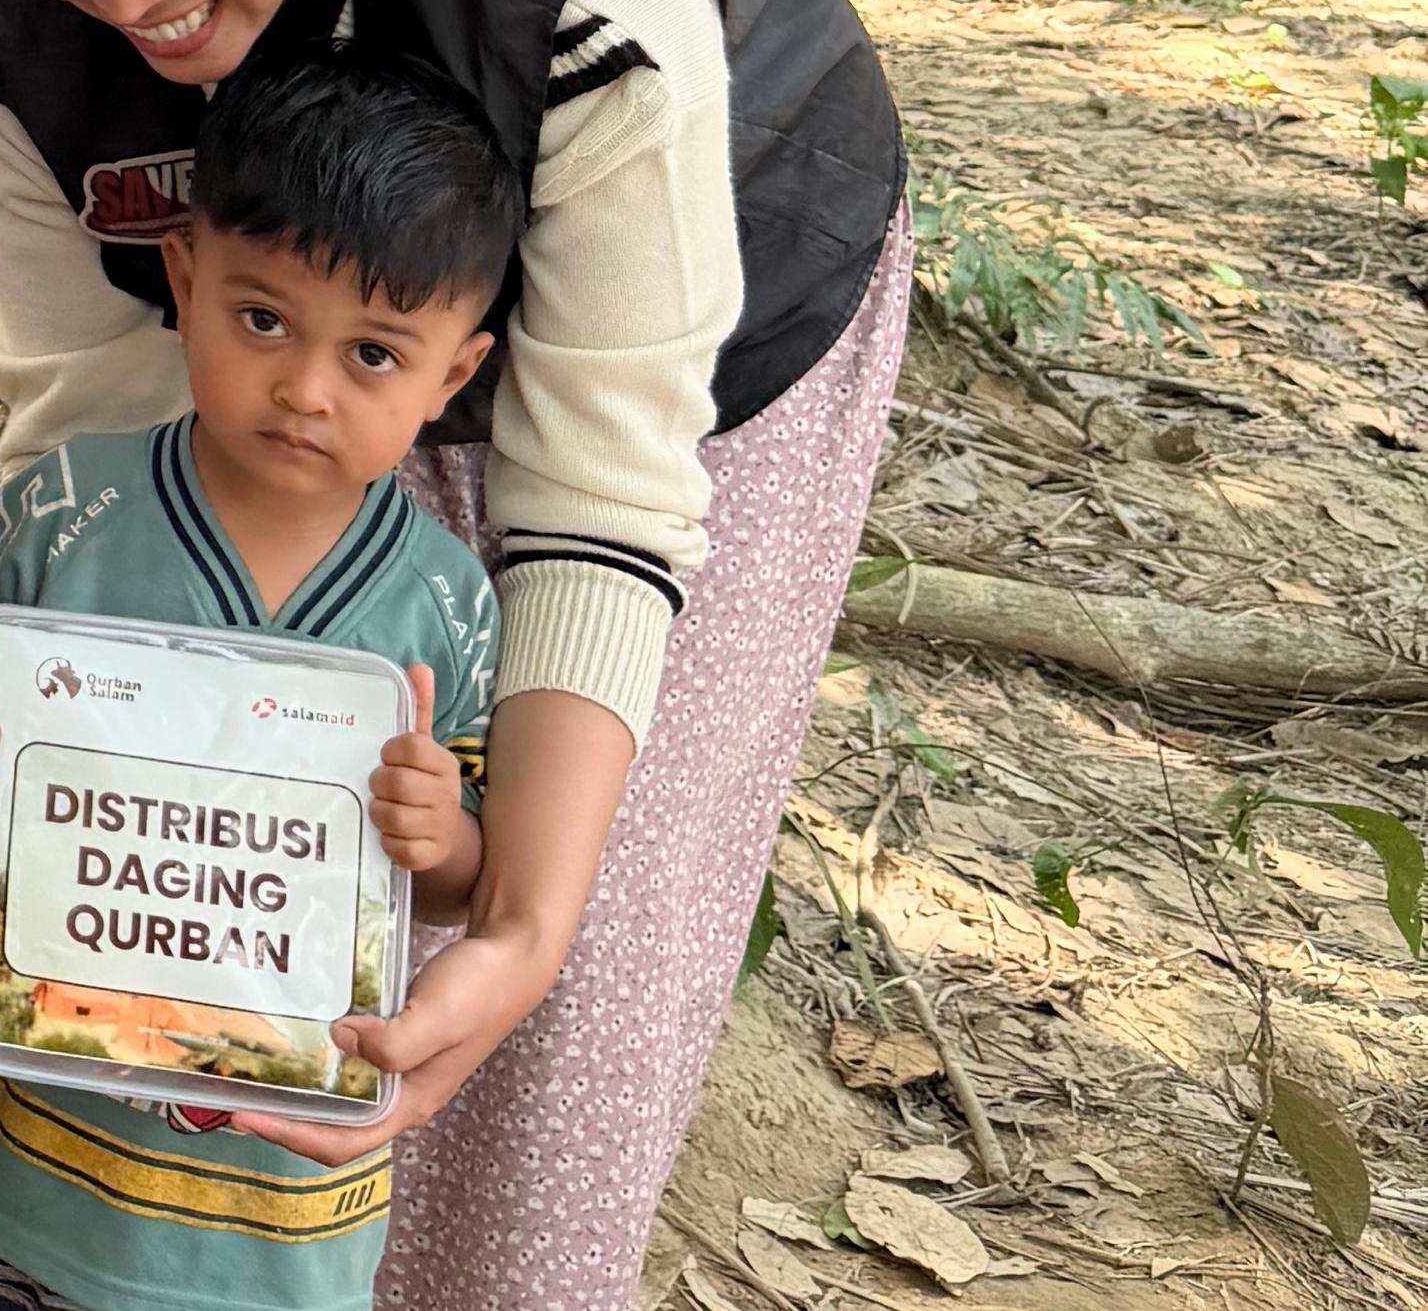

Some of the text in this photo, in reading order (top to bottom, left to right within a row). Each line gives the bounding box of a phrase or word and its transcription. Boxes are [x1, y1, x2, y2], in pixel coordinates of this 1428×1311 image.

[87, 673, 142, 691] Qurban
[282, 707, 355, 726] salamaid
[45, 783, 328, 862] DISTRIBUSI
[77, 845, 288, 913] DAGING
[65, 903, 291, 975] QURBAN
